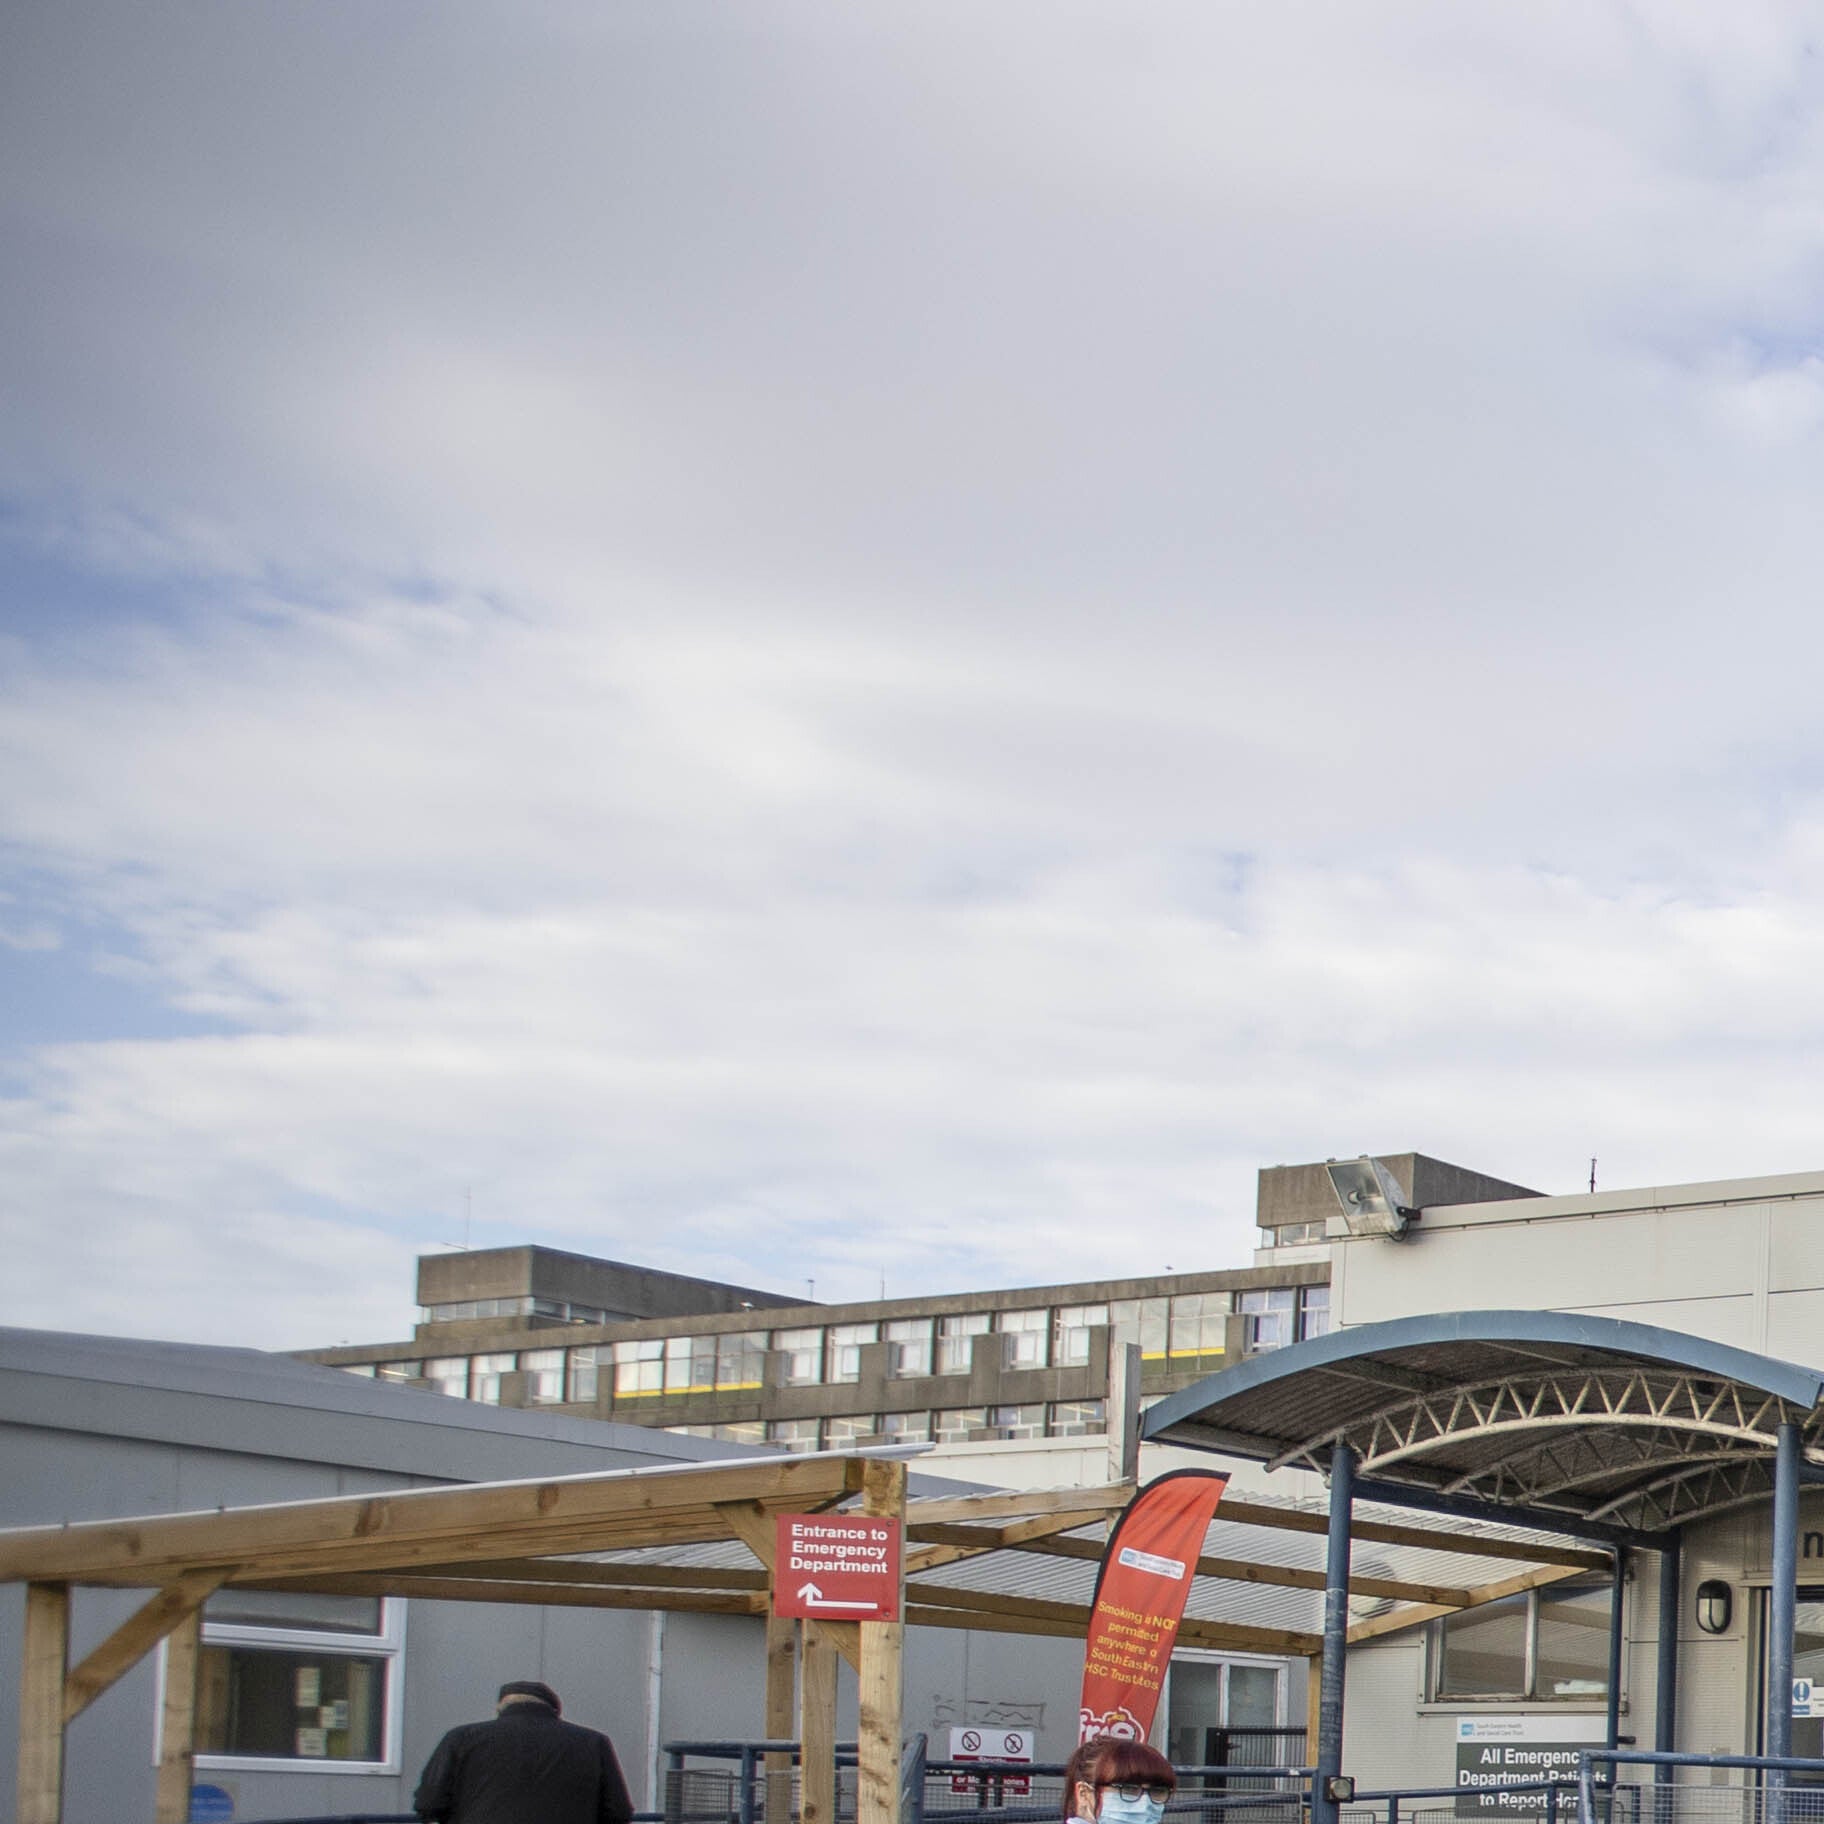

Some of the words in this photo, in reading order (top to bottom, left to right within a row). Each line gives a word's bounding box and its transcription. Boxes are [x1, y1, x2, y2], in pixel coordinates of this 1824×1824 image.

[791, 1524, 866, 1539] Entrance
[871, 1529, 888, 1541] to
[792, 1540, 887, 1559] Emergency
[790, 1557, 888, 1573] Department
[1097, 1600, 1143, 1624] Smoking
[1097, 1635, 1146, 1655] anywhere
[1091, 1647, 1122, 1665] South
[1086, 1661, 1109, 1677] HSC
[1480, 1748, 1500, 1765] All
[1505, 1749, 1580, 1768] Emergenc
[1459, 1770, 1545, 1786] Department
[1480, 1793, 1495, 1806] to
[1499, 1792, 1549, 1811] Report
